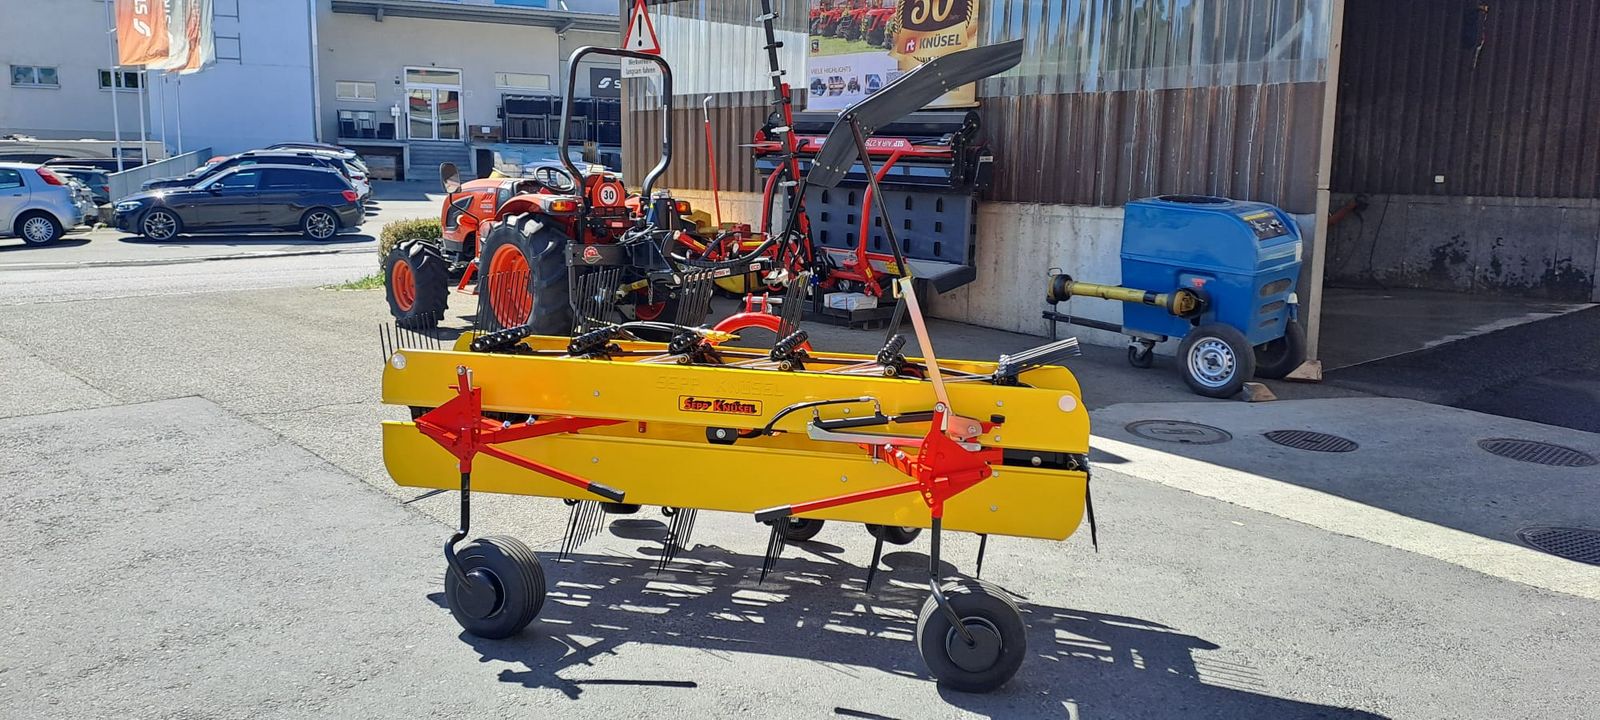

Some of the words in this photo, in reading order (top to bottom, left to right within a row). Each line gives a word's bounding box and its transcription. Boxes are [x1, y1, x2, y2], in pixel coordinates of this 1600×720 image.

[920, 34, 962, 49] KNÜSEL
[603, 190, 614, 200] 30
[713, 399, 757, 414] KNÜSEL
